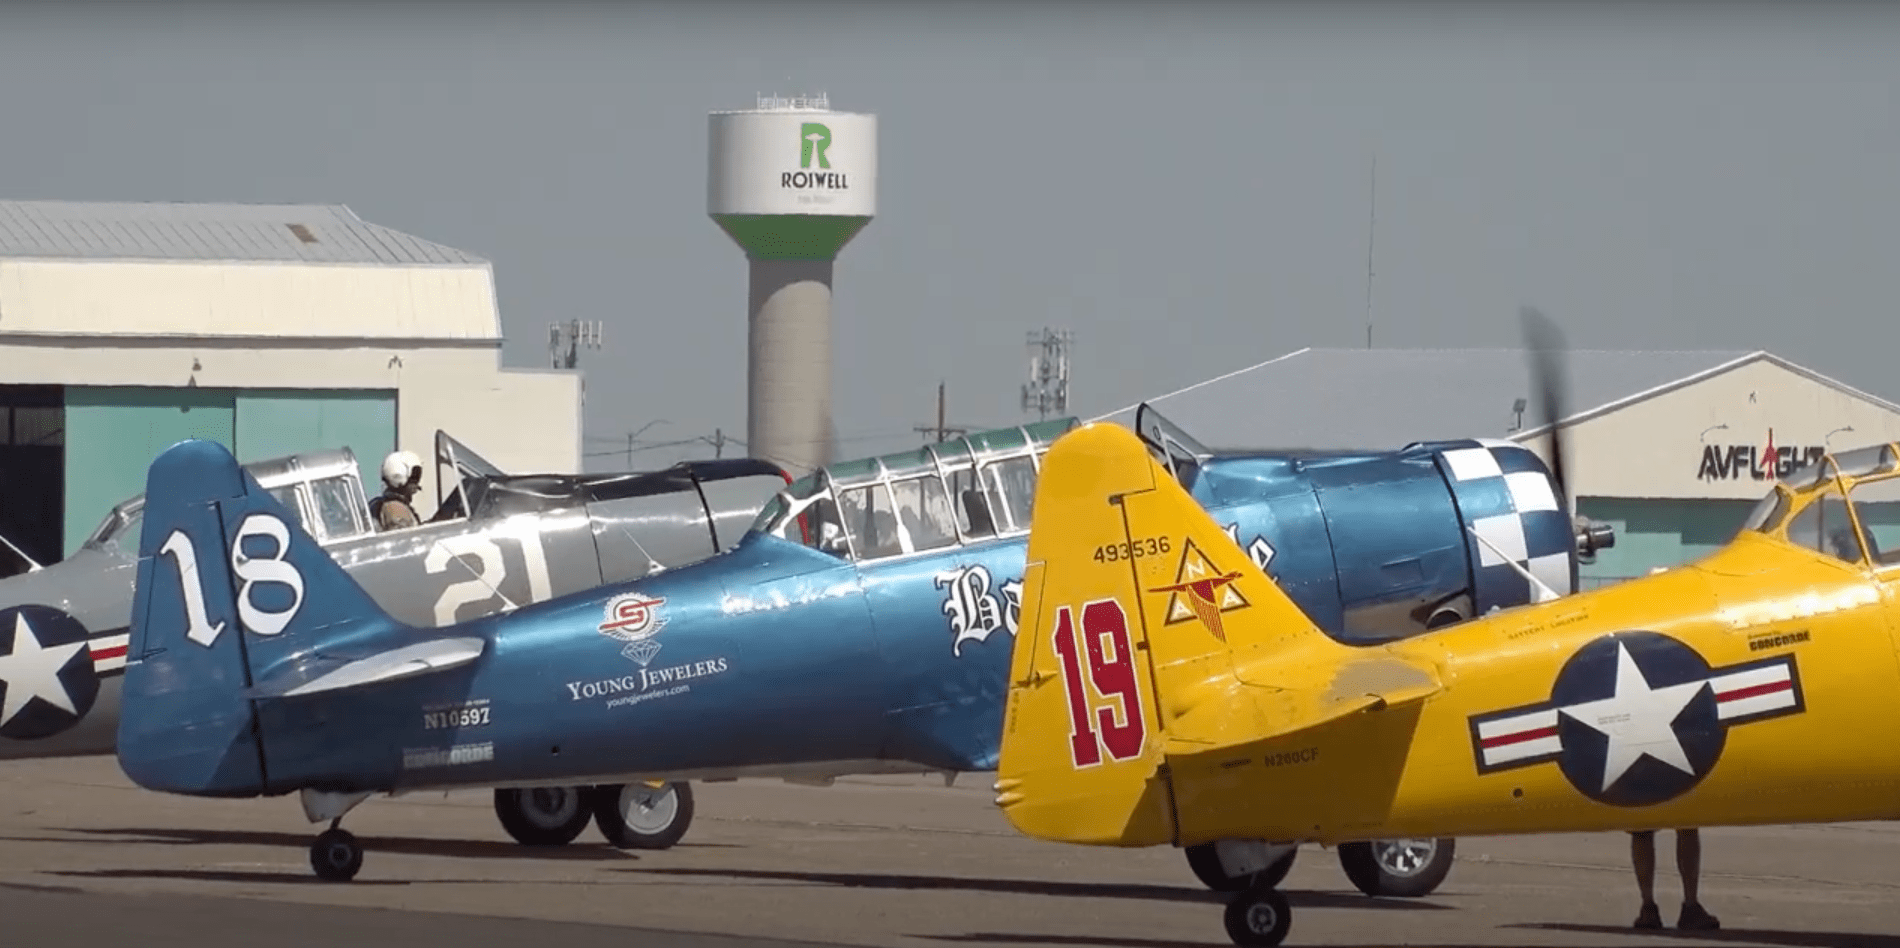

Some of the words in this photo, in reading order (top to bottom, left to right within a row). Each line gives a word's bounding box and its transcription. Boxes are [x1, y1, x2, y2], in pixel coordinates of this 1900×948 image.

[159, 513, 304, 648] 18
[424, 522, 553, 628] 21
[1093, 536, 1171, 564] 493536
[423, 706, 491, 730] N10597
[606, 683, 690, 710] youngjewelers.com
[1052, 598, 1147, 771] 19
